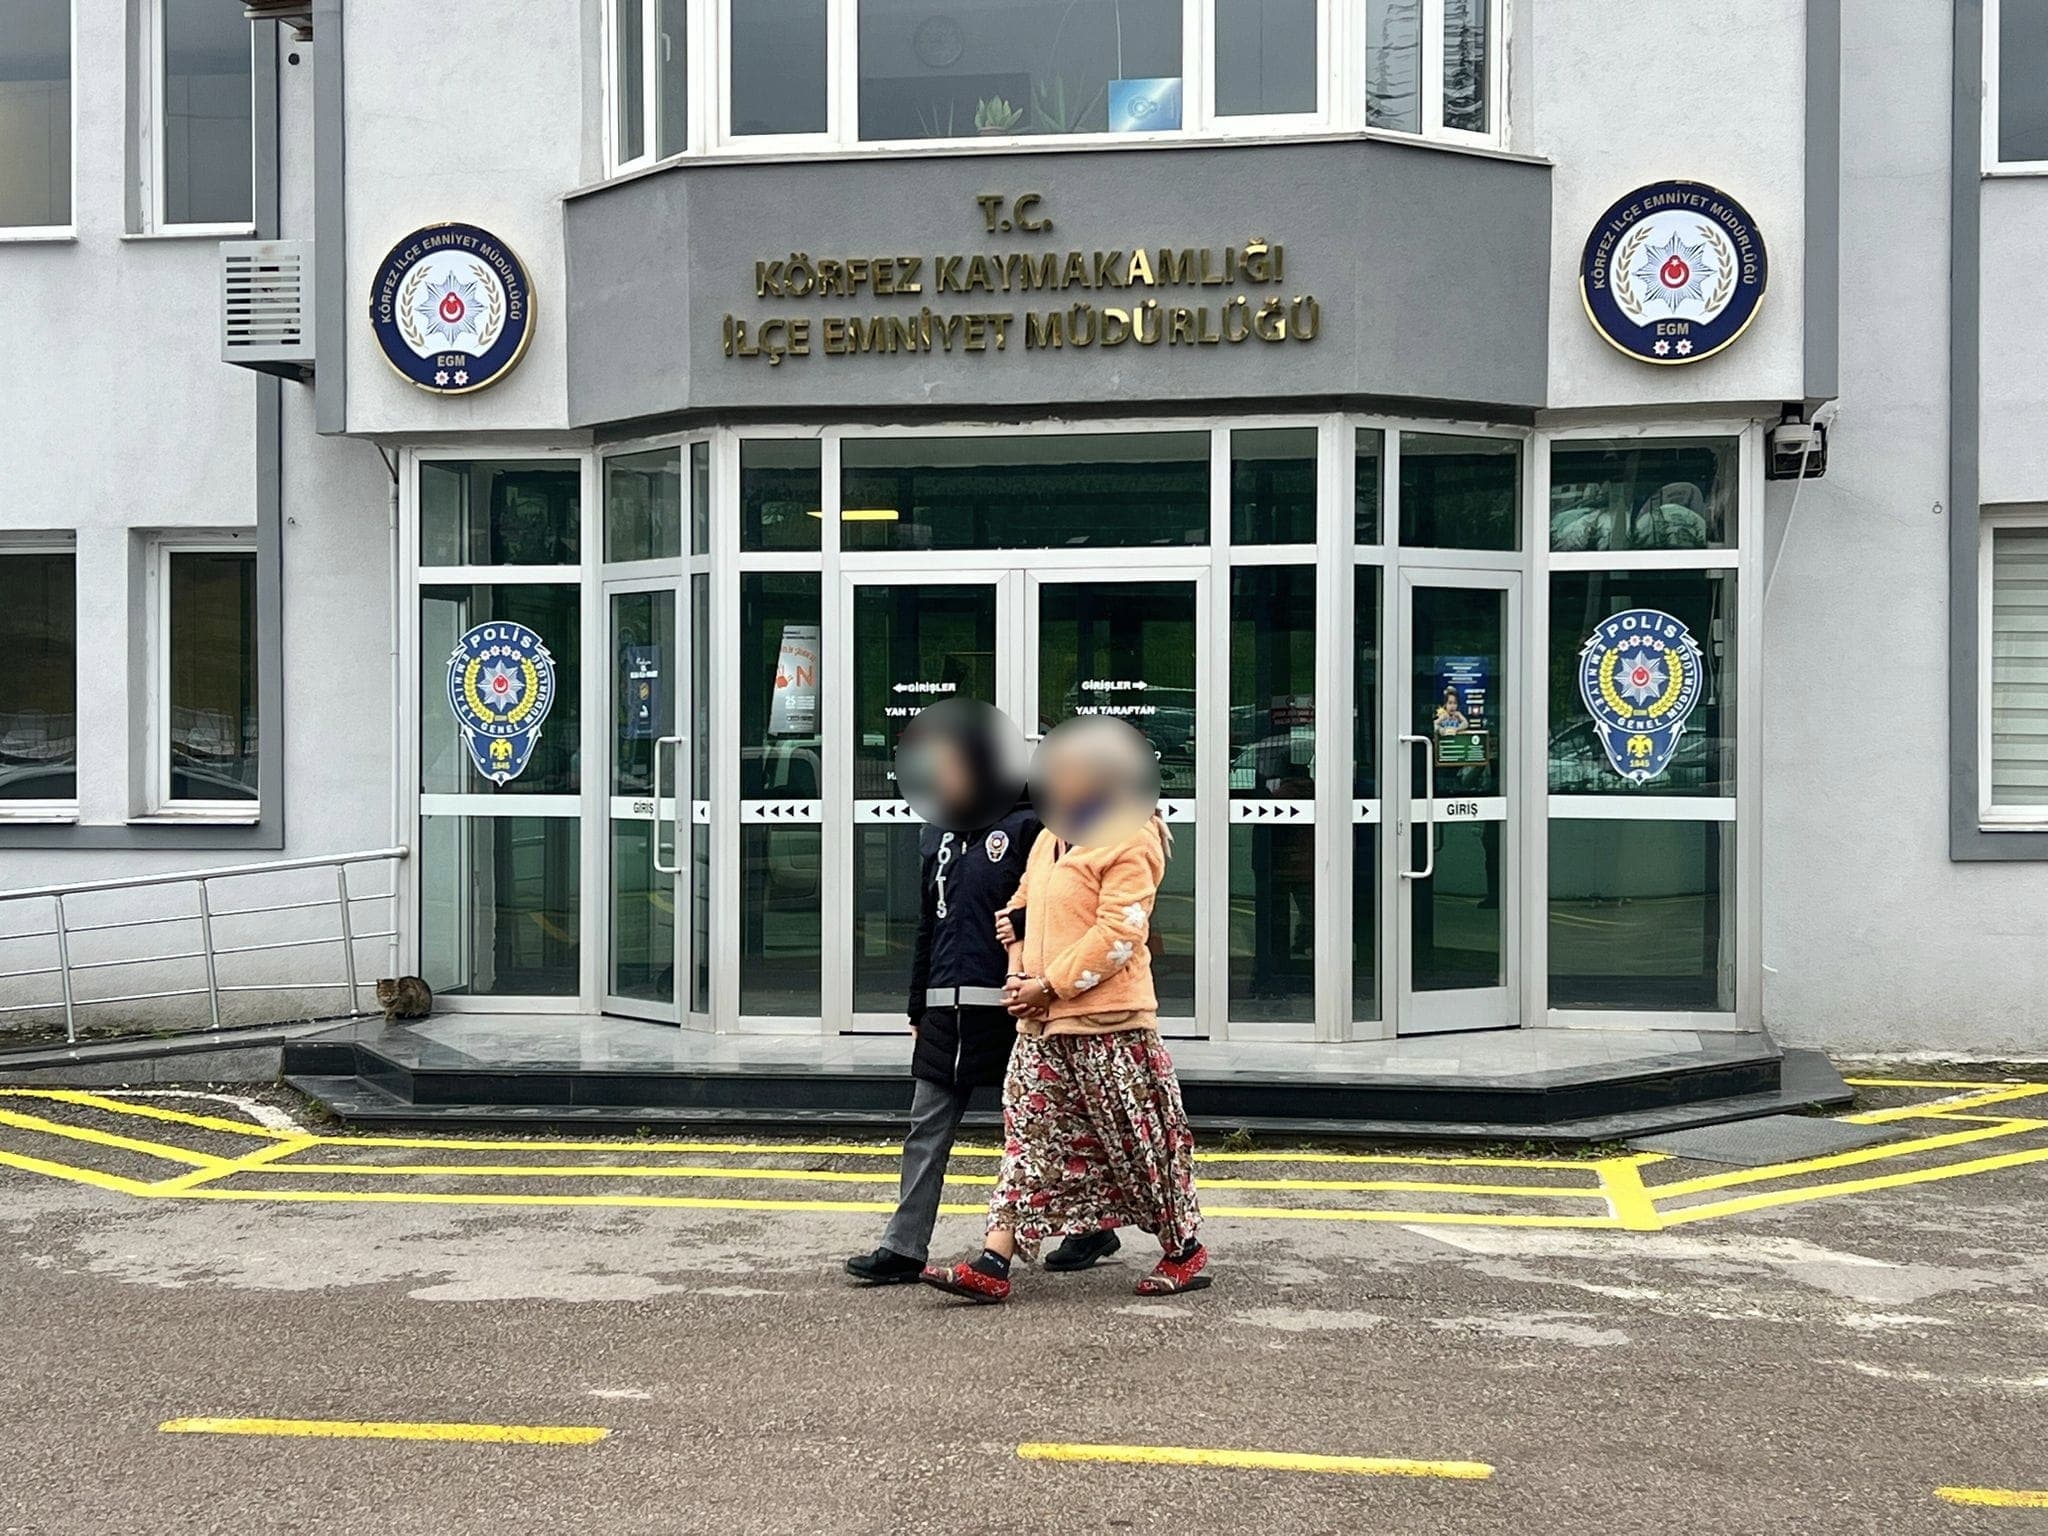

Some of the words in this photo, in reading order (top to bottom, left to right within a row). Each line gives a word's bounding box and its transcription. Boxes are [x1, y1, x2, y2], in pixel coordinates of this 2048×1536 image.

[977, 193, 1053, 233] T.C.
[1591, 232, 1616, 289] KÖRFEZ
[1611, 204, 1642, 232] İLÇE
[1643, 190, 1709, 210] EMNİYET
[1710, 202, 1757, 284] MÜDÜRLÜĞÜ
[755, 252, 923, 296] KÖRFEZ
[935, 237, 1285, 292] KAYMAKAMLIĞI
[379, 268, 400, 323] KÖRFEZ
[395, 244, 422, 271] İLÇE
[422, 232, 479, 249] EMNİYET
[479, 243, 522, 320] MÜDÜRLÜĞÜ
[722, 309, 810, 365] İLÇE
[822, 306, 1013, 356] EMNİYET
[1024, 295, 1322, 349] MÜDÜRLÜĞÜ
[1656, 323, 1689, 336] EGM
[437, 355, 465, 367] EGM
[1606, 615, 1677, 638] POLİS
[470, 626, 533, 649] POLİS
[908, 682, 956, 694] GİRİŞLER
[1081, 680, 1131, 692] GİRİŞLER
[885, 707, 907, 716] YAN
[1075, 705, 1098, 715] YAN
[1099, 705, 1156, 715] TARAFTAN
[481, 721, 521, 734] GENEL
[1617, 717, 1663, 730] GENEL
[1446, 801, 1478, 818] GİRİŞ
